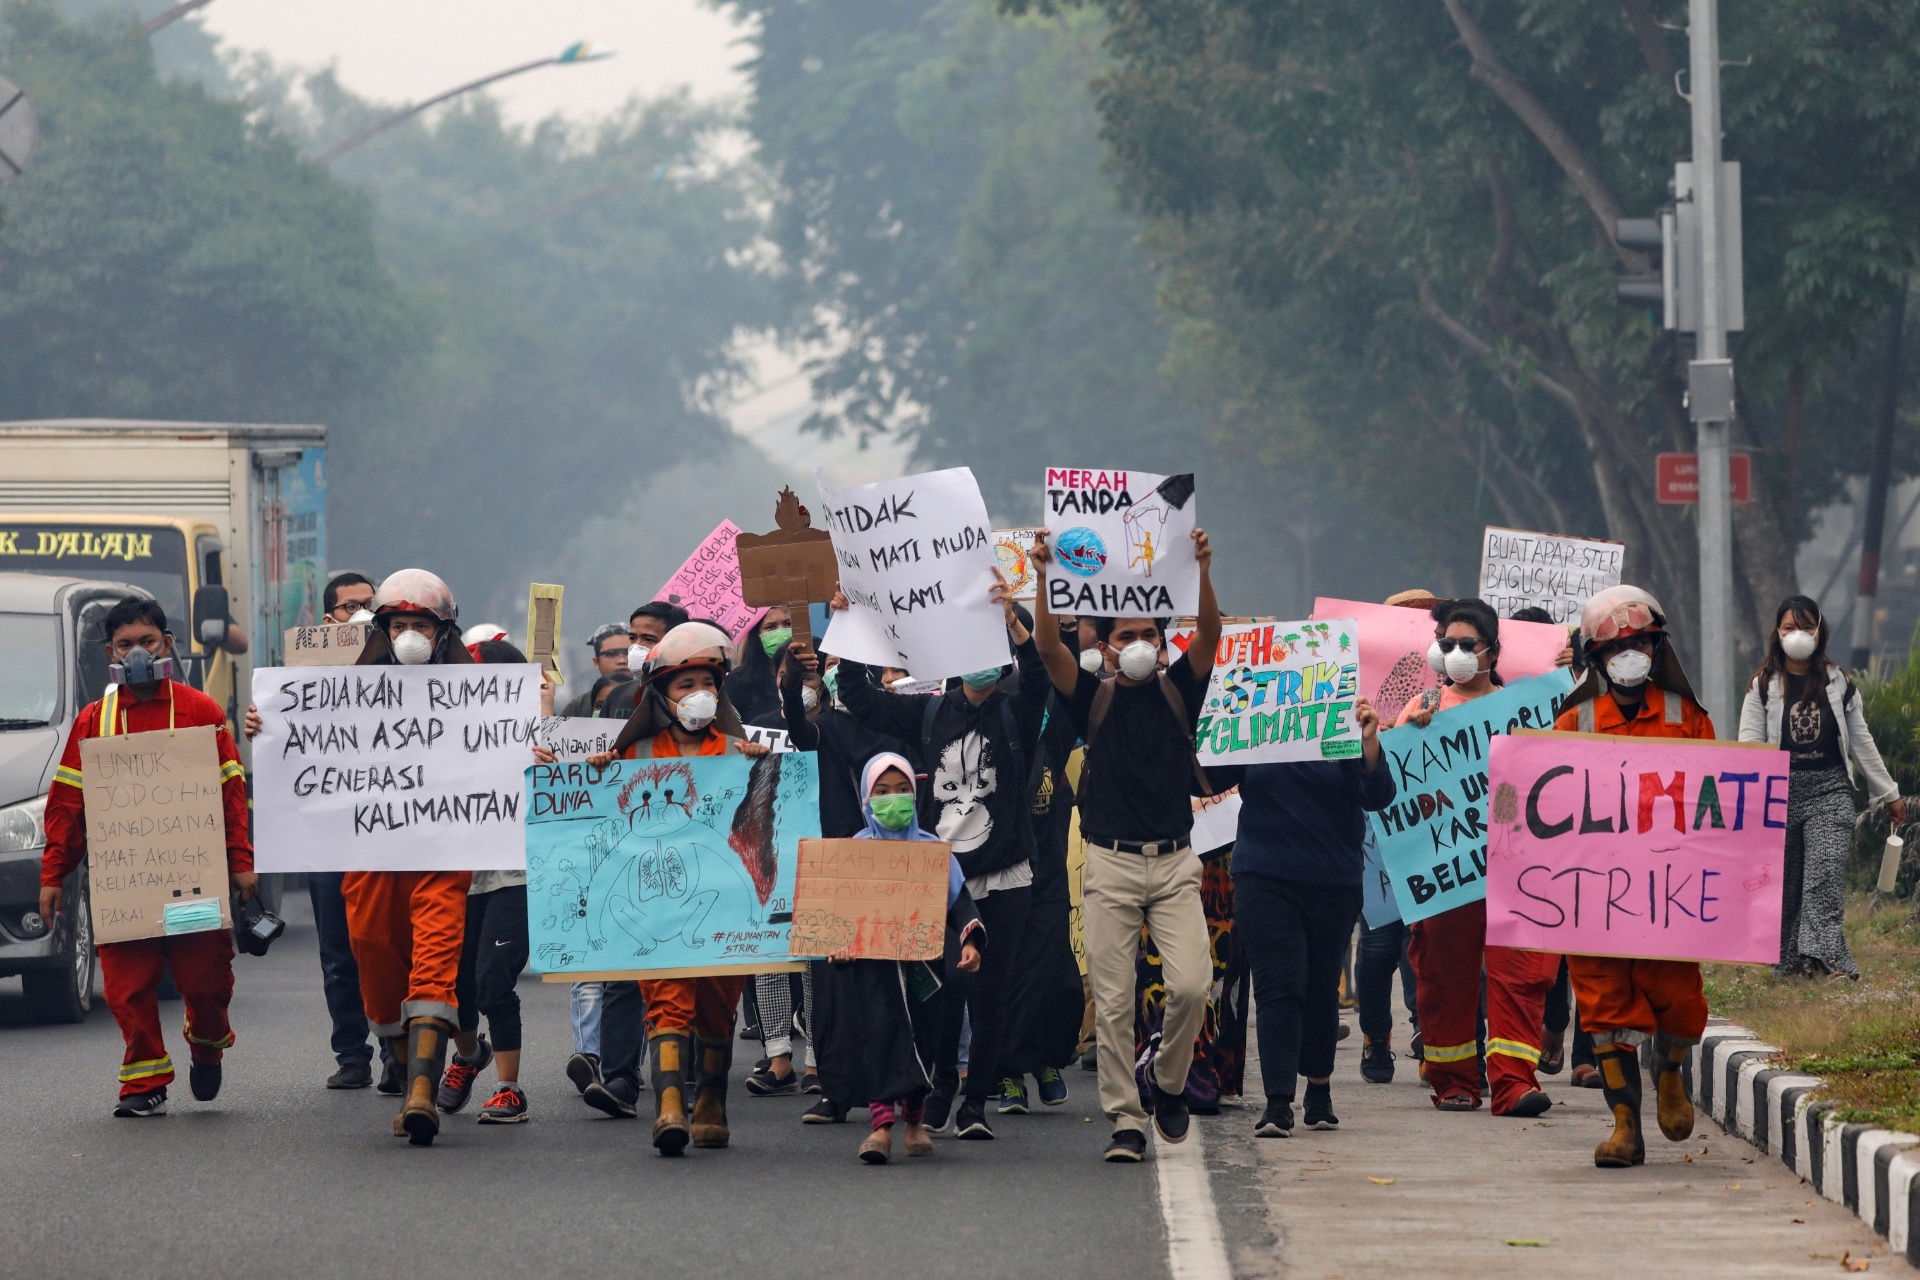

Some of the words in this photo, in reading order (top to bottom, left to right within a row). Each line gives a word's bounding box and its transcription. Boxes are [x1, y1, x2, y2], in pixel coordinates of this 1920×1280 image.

[1048, 469, 1127, 491] MERAH
[835, 489, 917, 533] TIDAK
[1048, 489, 1133, 516] TANDA
[715, 545, 738, 564] Tha
[869, 537, 922, 573] MATI
[932, 524, 988, 560] MUDA
[1488, 534, 1533, 562] BUAT
[1531, 540, 1563, 568] APA
[1563, 544, 1620, 574] POSTER
[1049, 578, 1175, 613] BAHAYA
[1485, 563, 1544, 594] BAGUS
[889, 580, 945, 621] KAMI
[295, 627, 331, 650] ACT
[1170, 625, 1275, 668] YUTH
[280, 671, 403, 712] SEDIAKAN
[427, 673, 524, 711] RUMAH
[1223, 660, 1358, 715] STRIKE
[283, 716, 360, 760] AMAN
[370, 717, 444, 755] ASAP
[463, 716, 540, 753] UNTUK
[97, 752, 170, 779] UNTUK
[1390, 725, 1482, 792] KAMI
[293, 764, 424, 799] GENERASI
[354, 789, 520, 837] KALIMANTAN
[534, 789, 594, 816] DUNIA
[1378, 789, 1455, 837] MUDA
[1430, 807, 1488, 855] KAR
[94, 848, 138, 870] MAAF
[1406, 844, 1487, 905] BELU
[100, 907, 144, 928] PAKAI
[1508, 864, 1722, 931] STRIKE
[723, 943, 760, 955] STRIKE
